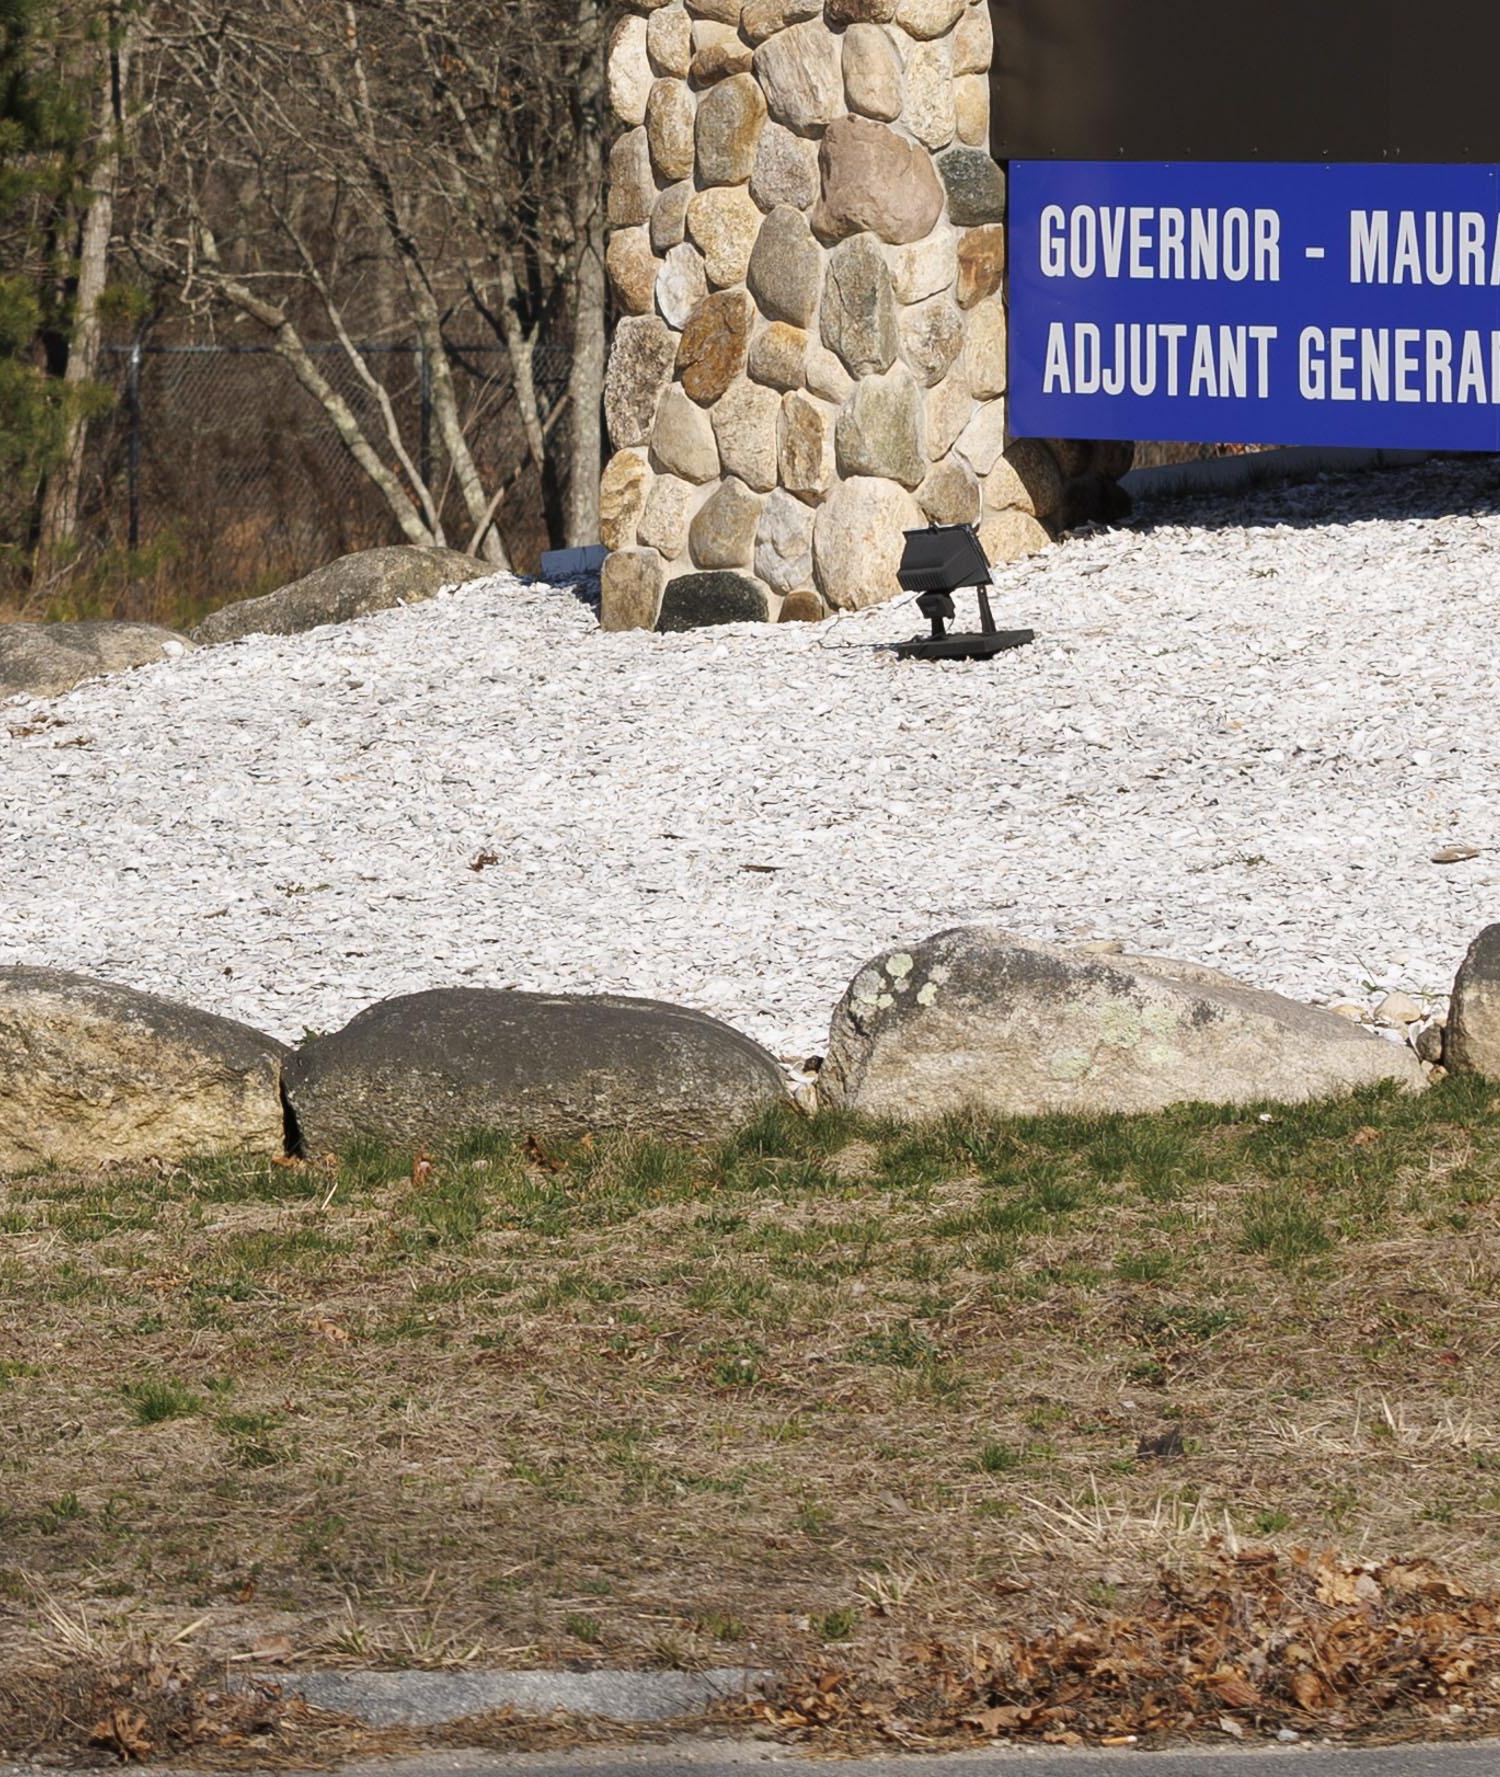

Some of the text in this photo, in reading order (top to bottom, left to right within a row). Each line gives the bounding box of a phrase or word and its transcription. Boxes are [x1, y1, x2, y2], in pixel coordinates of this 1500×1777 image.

[1040, 204, 1280, 282] GOVERNOR
[1305, 247, 1325, 258] -
[1042, 322, 1278, 398] ADJUTANT
